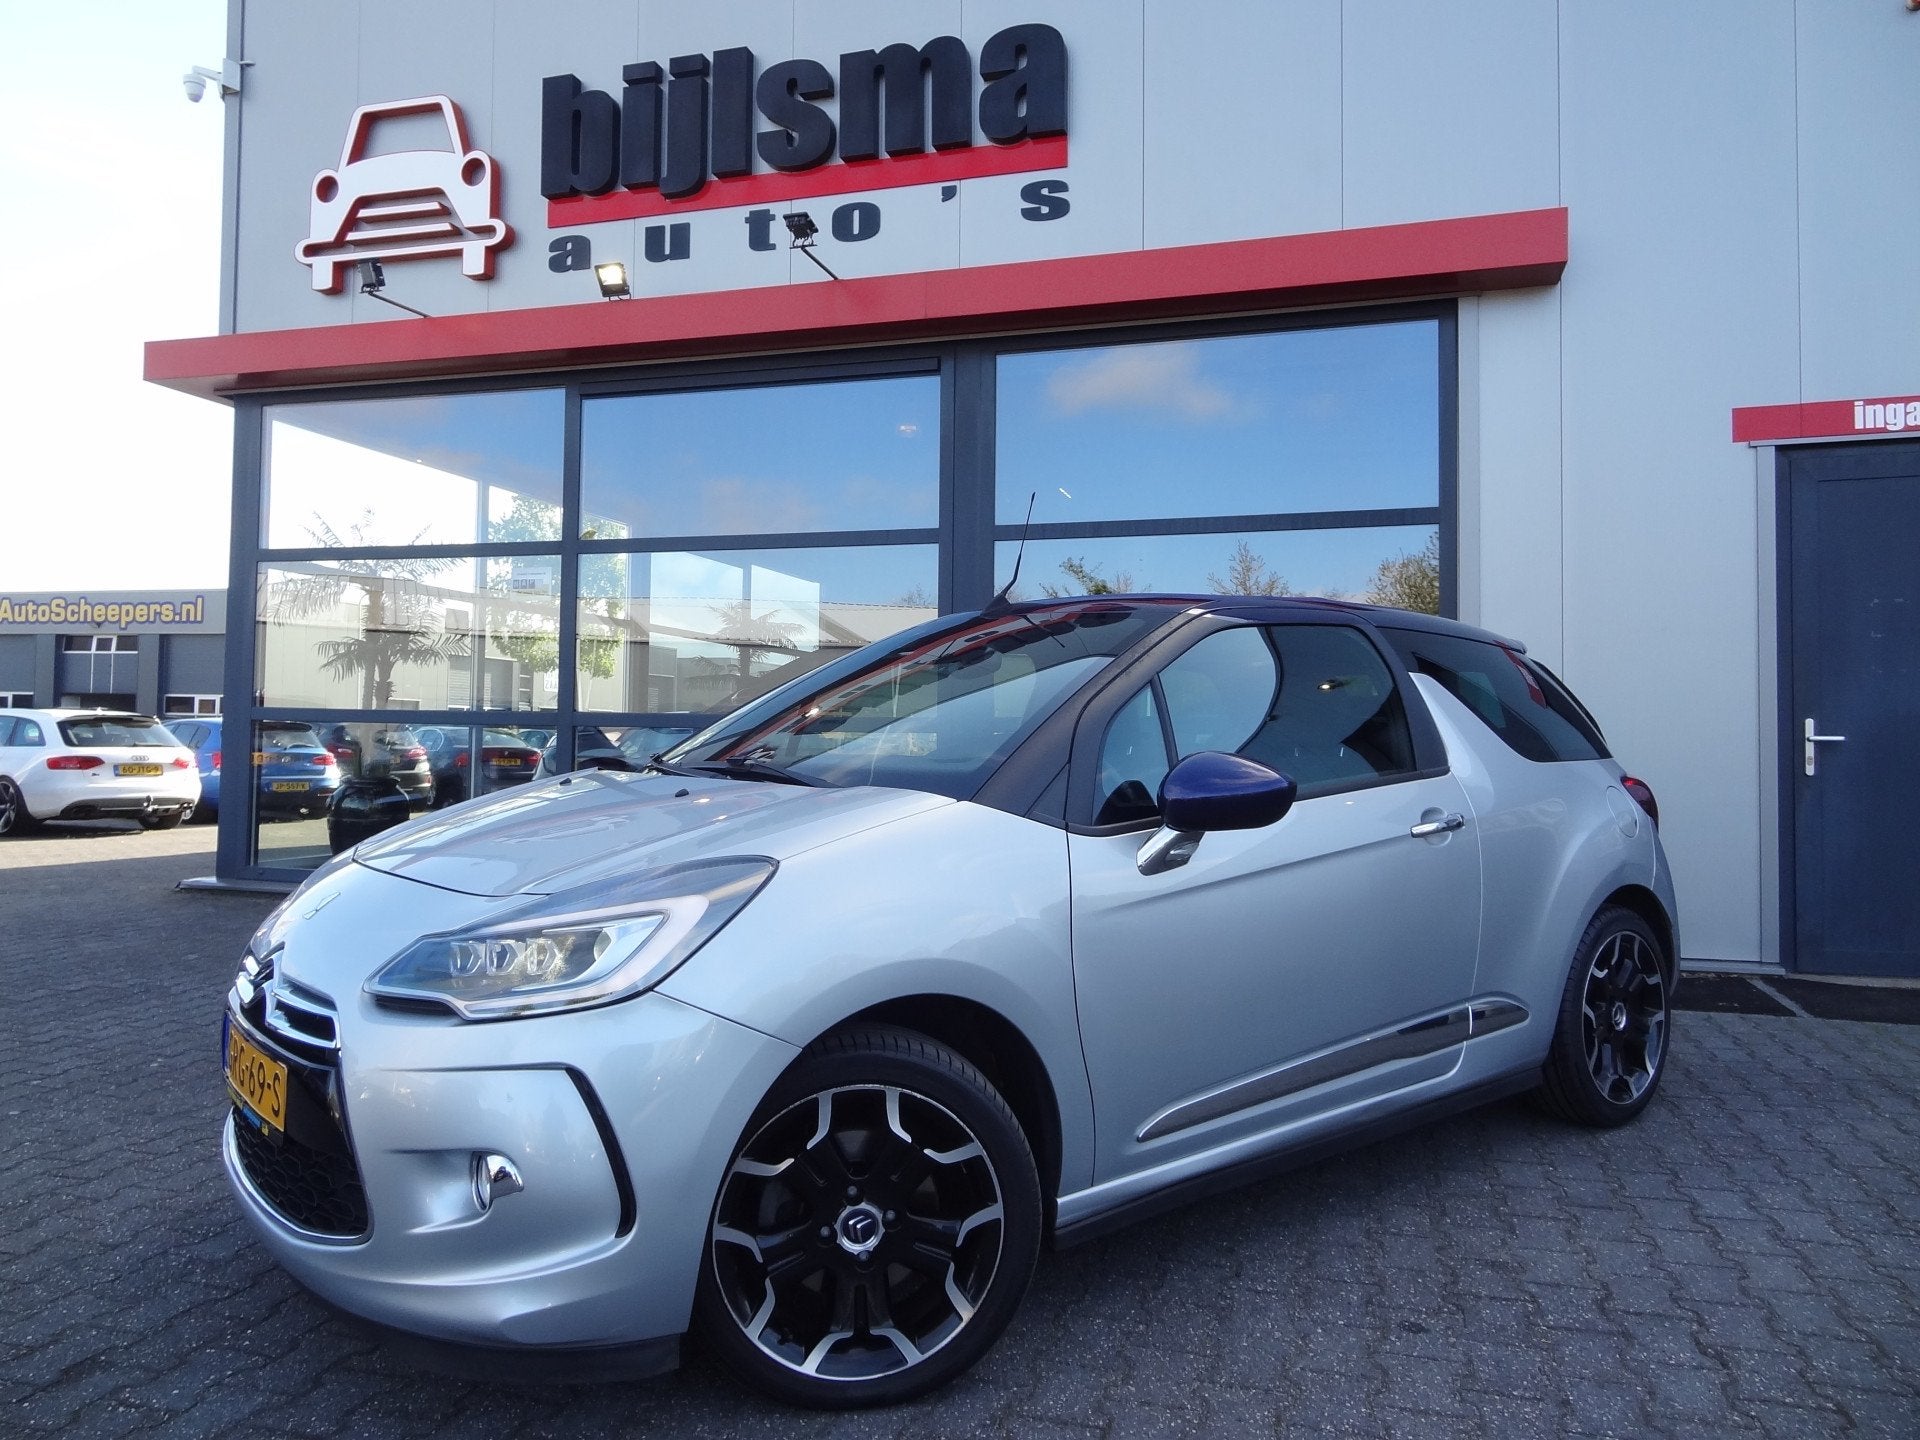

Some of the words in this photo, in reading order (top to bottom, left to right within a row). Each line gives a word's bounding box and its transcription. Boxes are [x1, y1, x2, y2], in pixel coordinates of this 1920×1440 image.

[541, 22, 1068, 201] bijlsma
[547, 178, 1071, 274] auto's
[0, 595, 204, 630] AutoScheepers.nl
